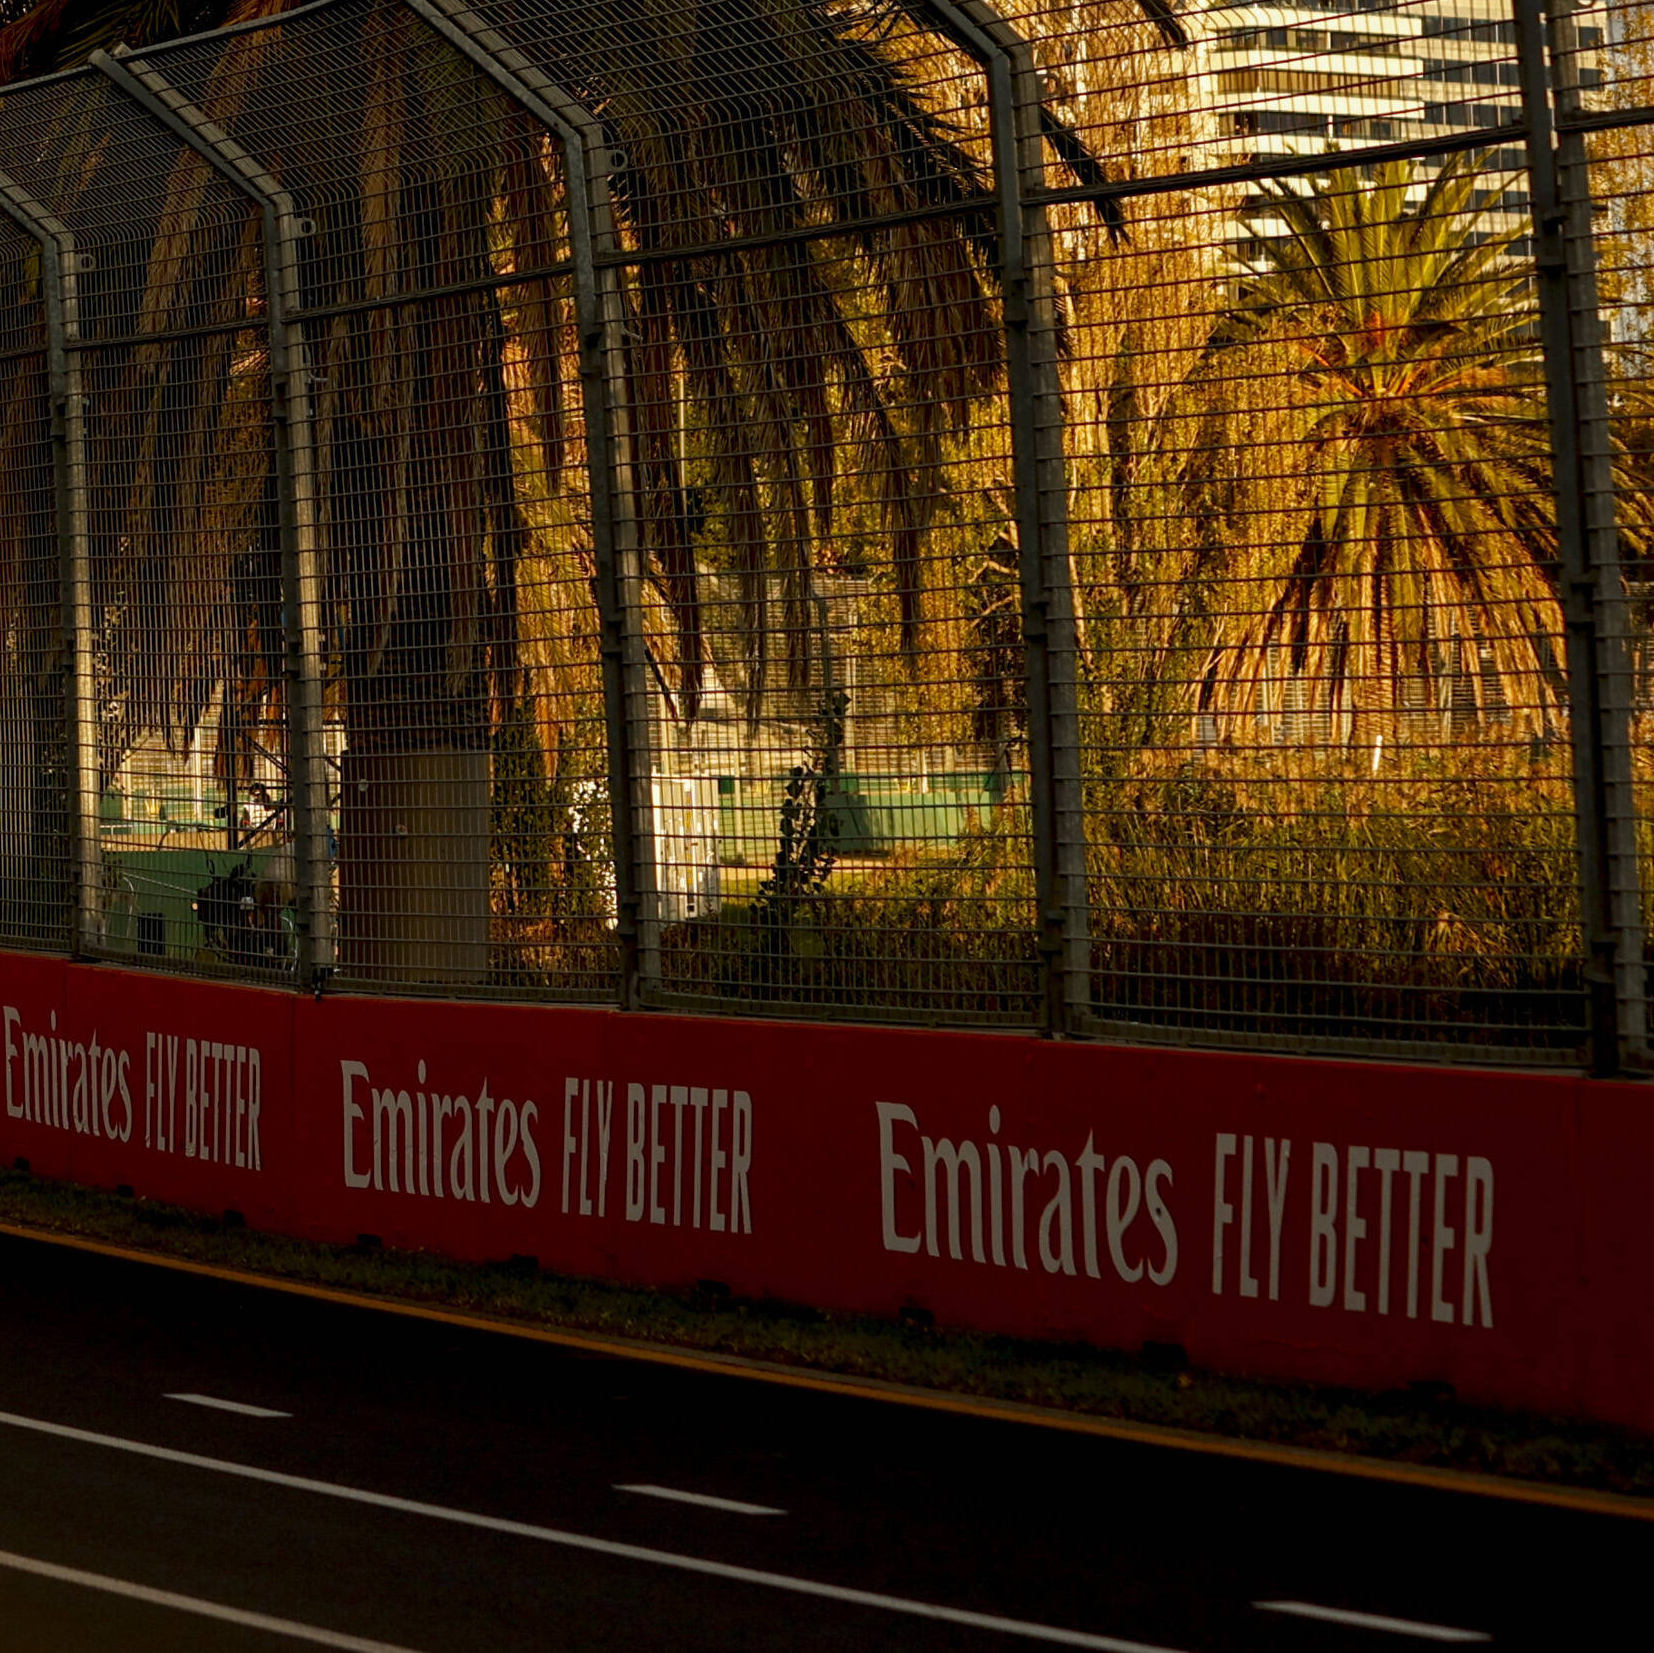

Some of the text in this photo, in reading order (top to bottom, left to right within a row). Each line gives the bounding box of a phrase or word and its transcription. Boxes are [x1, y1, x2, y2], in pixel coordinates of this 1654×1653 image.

[2, 1005, 261, 1171] Emirates FLY BETTER
[340, 1058, 753, 1235] Emirates FLY BETTER
[875, 1100, 1493, 1329] Emirates FLY BETTER
